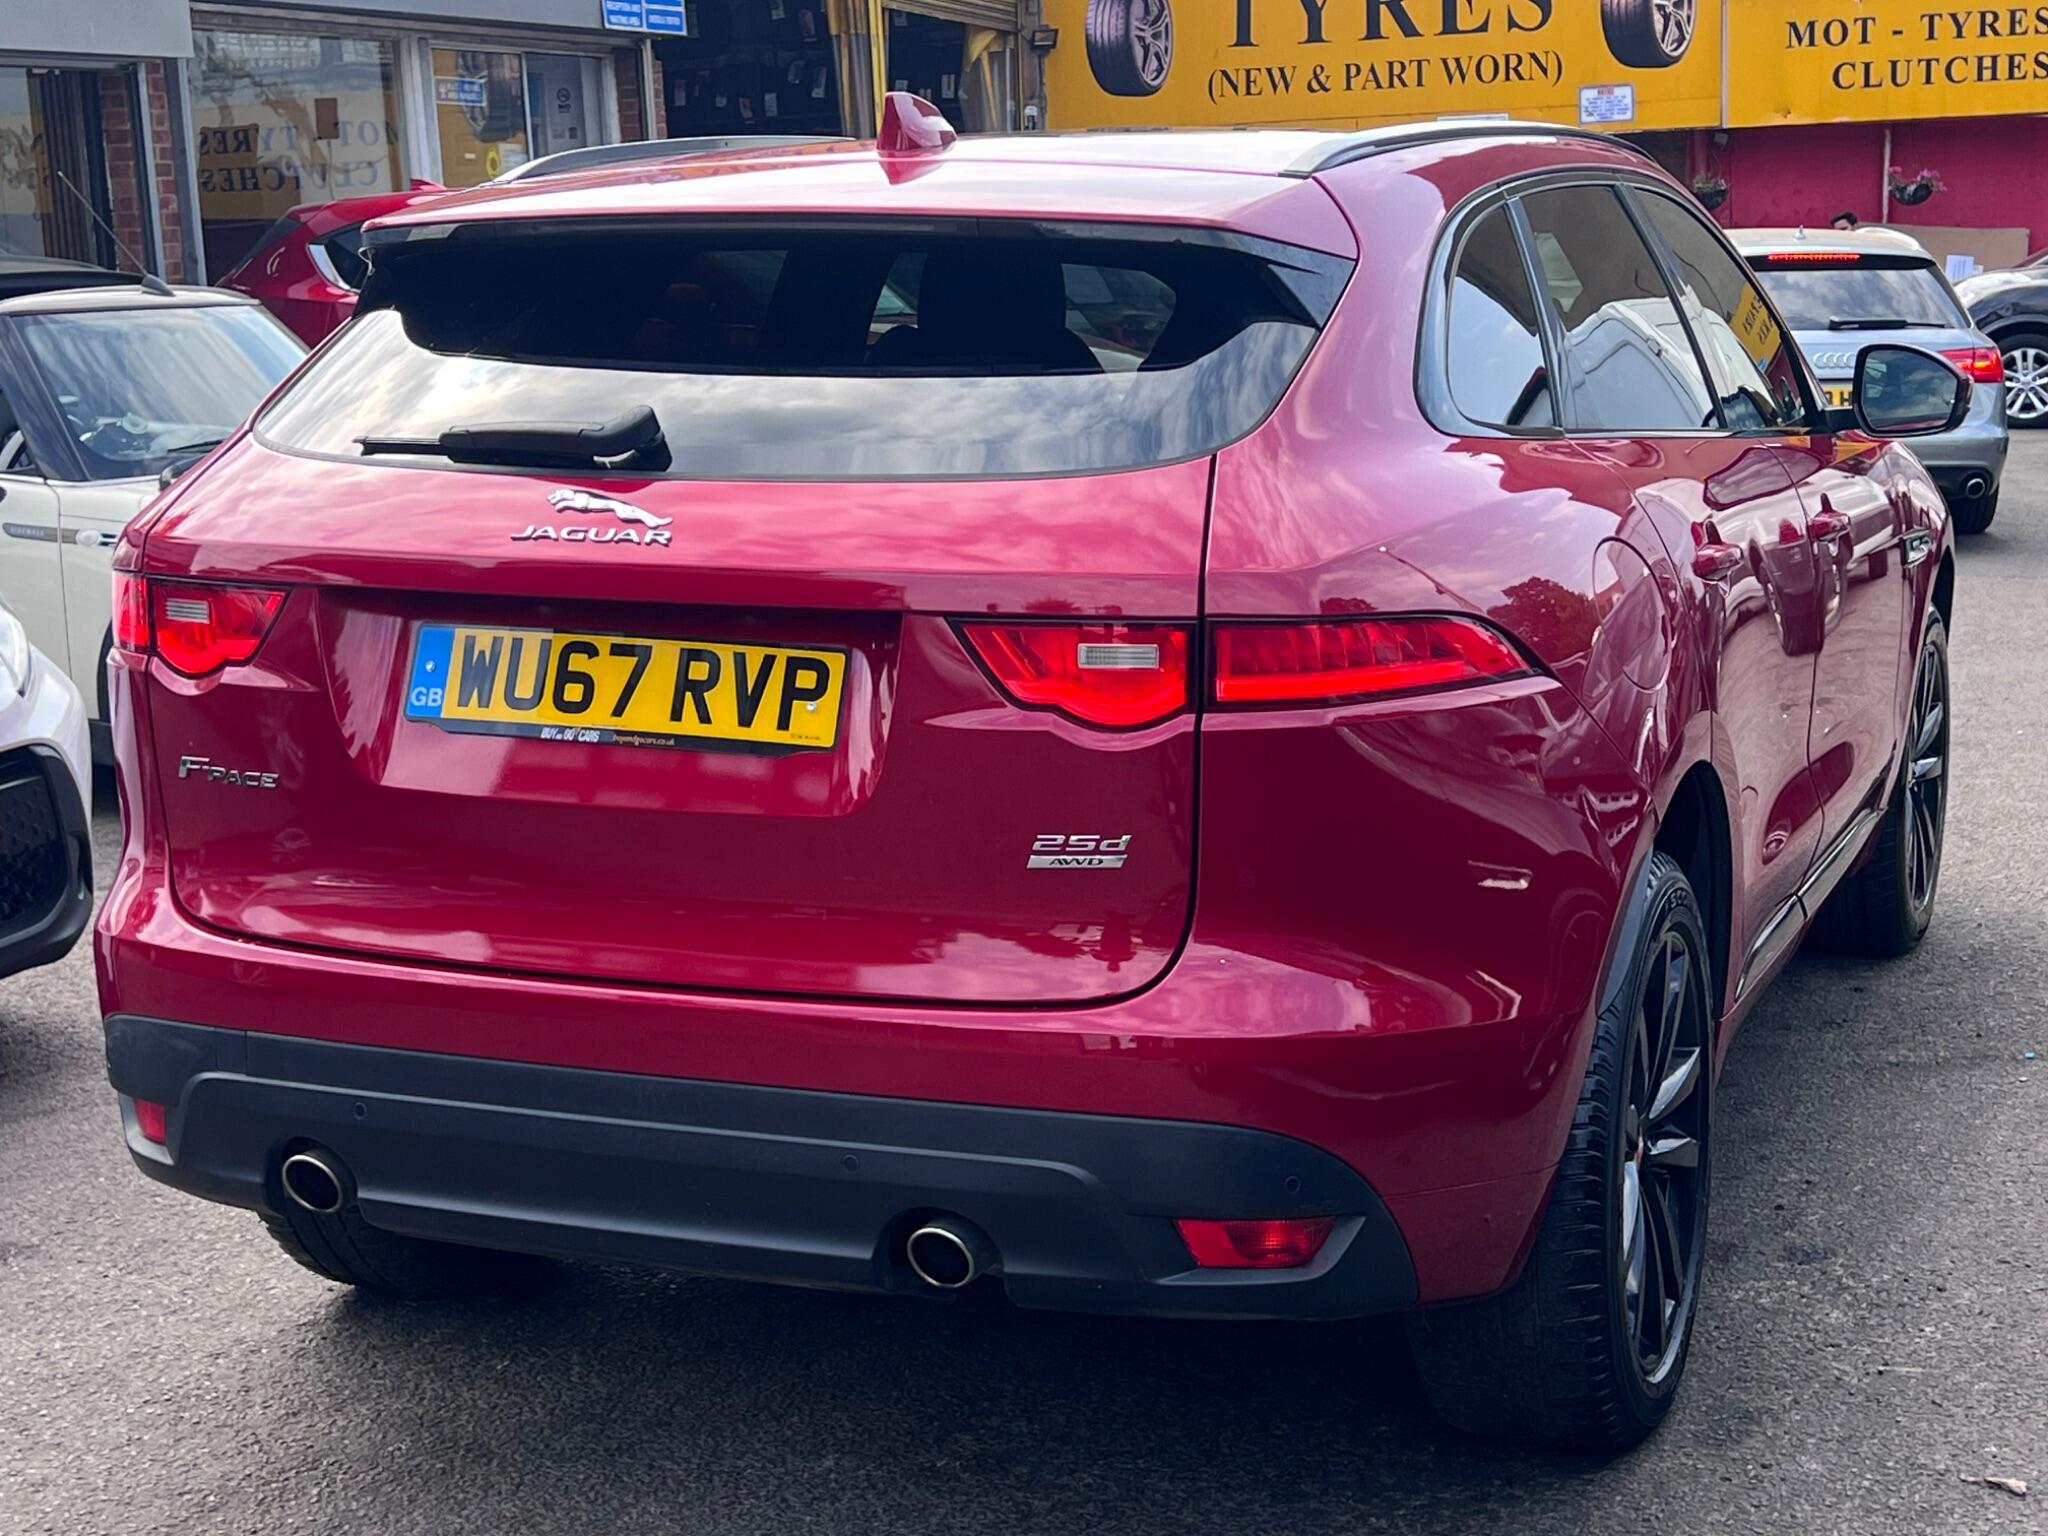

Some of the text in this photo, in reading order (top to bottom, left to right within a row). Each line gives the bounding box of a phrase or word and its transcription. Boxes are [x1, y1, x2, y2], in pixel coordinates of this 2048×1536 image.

[1785, 17, 1876, 48] MOT
[1920, 7, 2048, 41] TYRES
[1207, 50, 1563, 105] (NEW & PART WORN)
[1832, 51, 2048, 90] CLUTCHES
[510, 525, 673, 548] JAGUAR
[411, 686, 443, 708] GB
[456, 634, 831, 731] WU67 RVP
[1031, 834, 1132, 851] 25d
[1049, 857, 1104, 866] AWD
